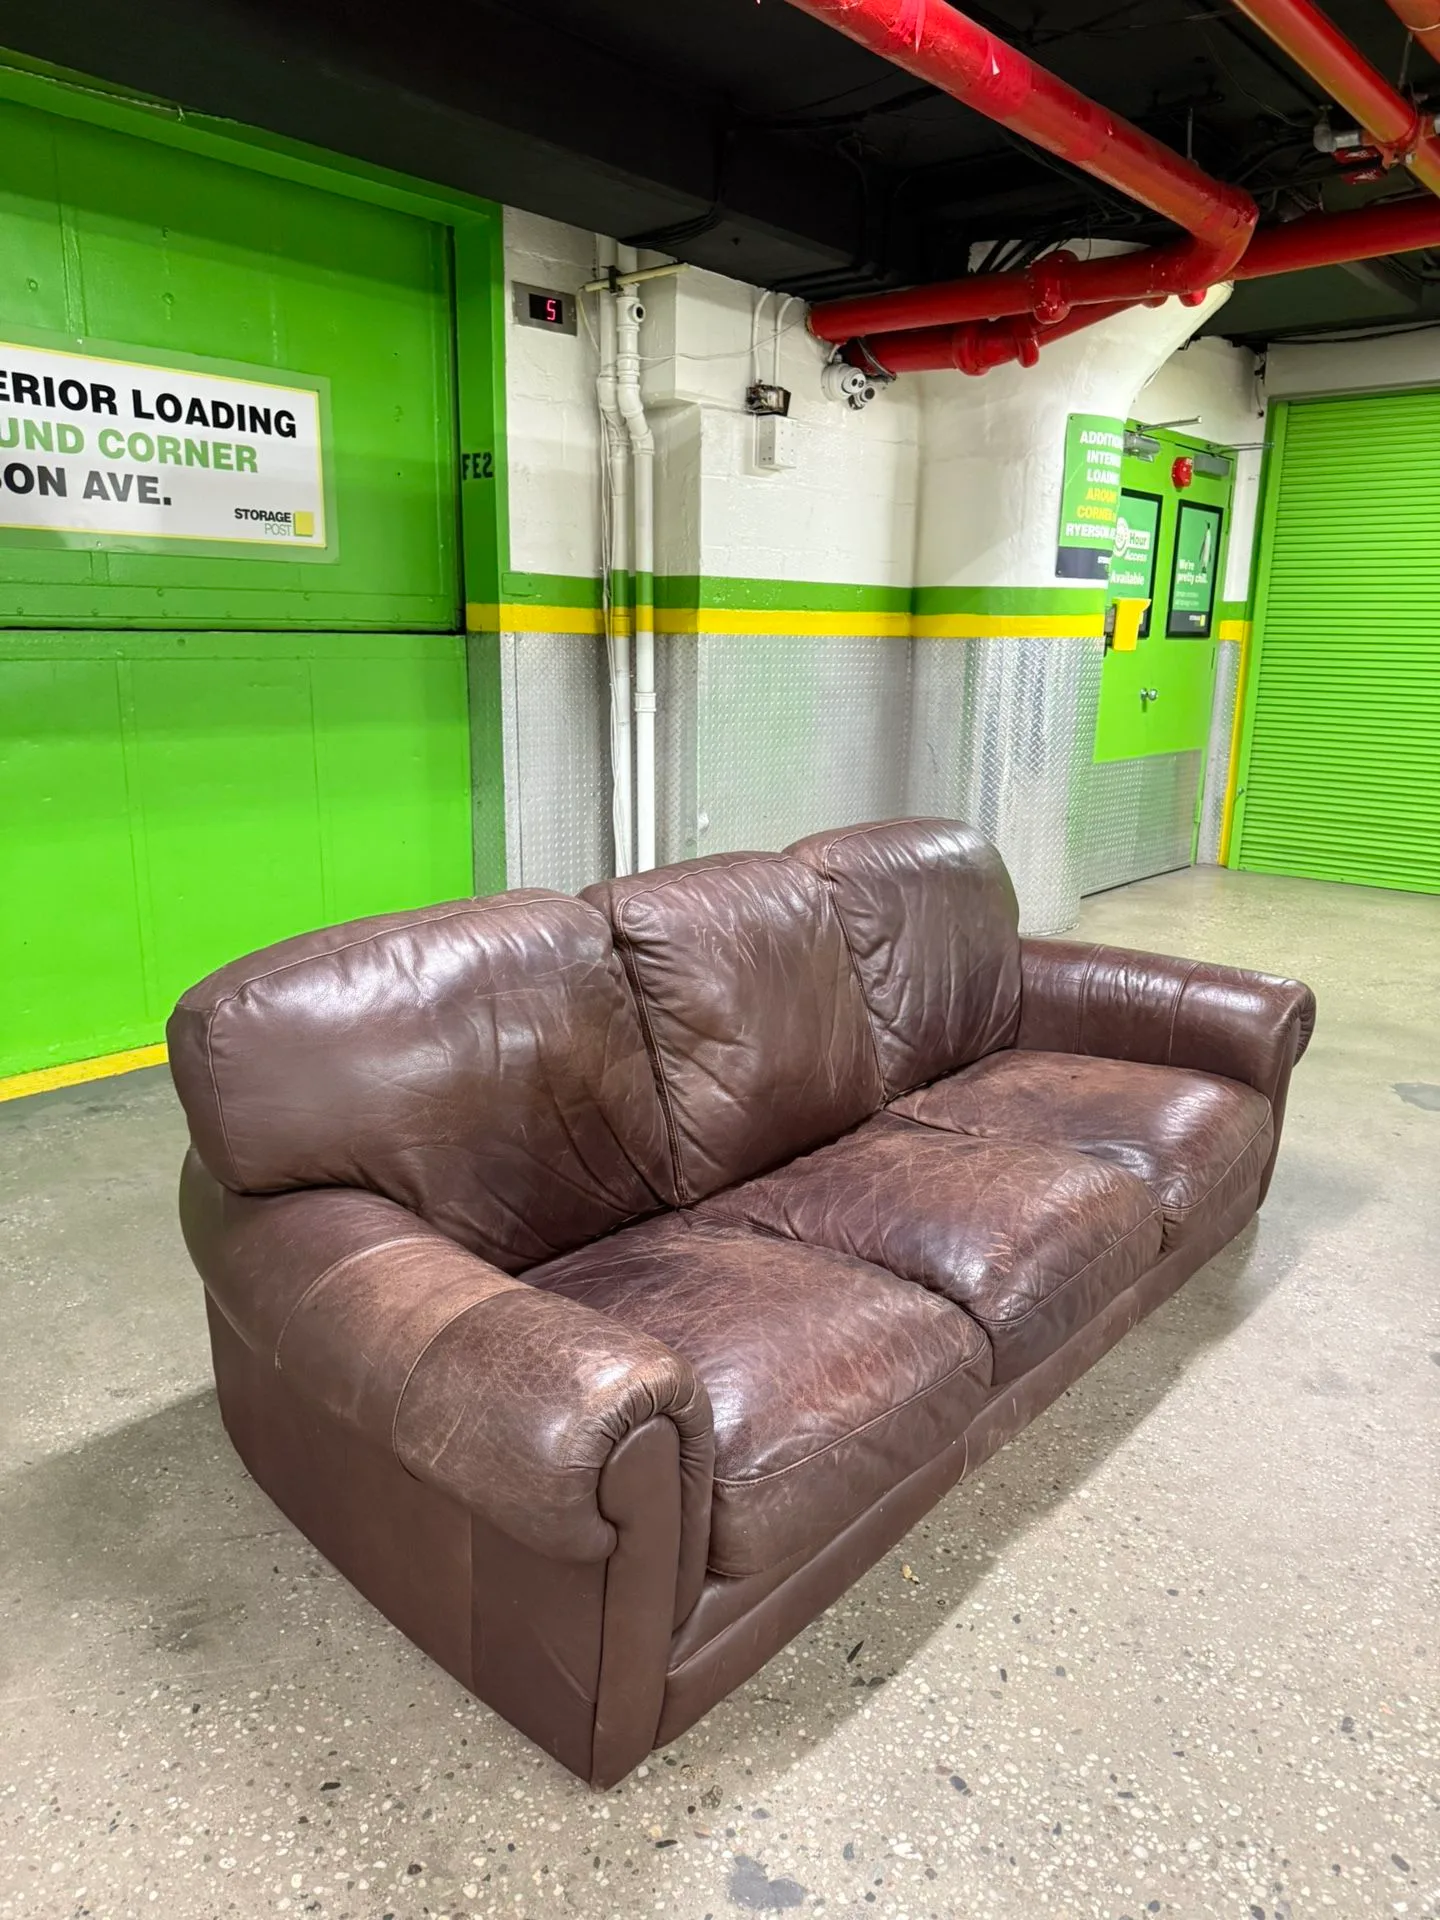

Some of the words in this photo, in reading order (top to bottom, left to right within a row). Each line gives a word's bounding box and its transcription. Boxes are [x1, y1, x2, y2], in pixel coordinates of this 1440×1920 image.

[546, 299, 556, 320] 5
[132, 389, 297, 438] LOADING
[98, 428, 258, 473] CORNER
[461, 452, 494, 480] FE2
[0, 462, 67, 497] ON
[83, 470, 172, 506] AVE.
[234, 508, 292, 523] STORAGE
[264, 523, 292, 536] POST
